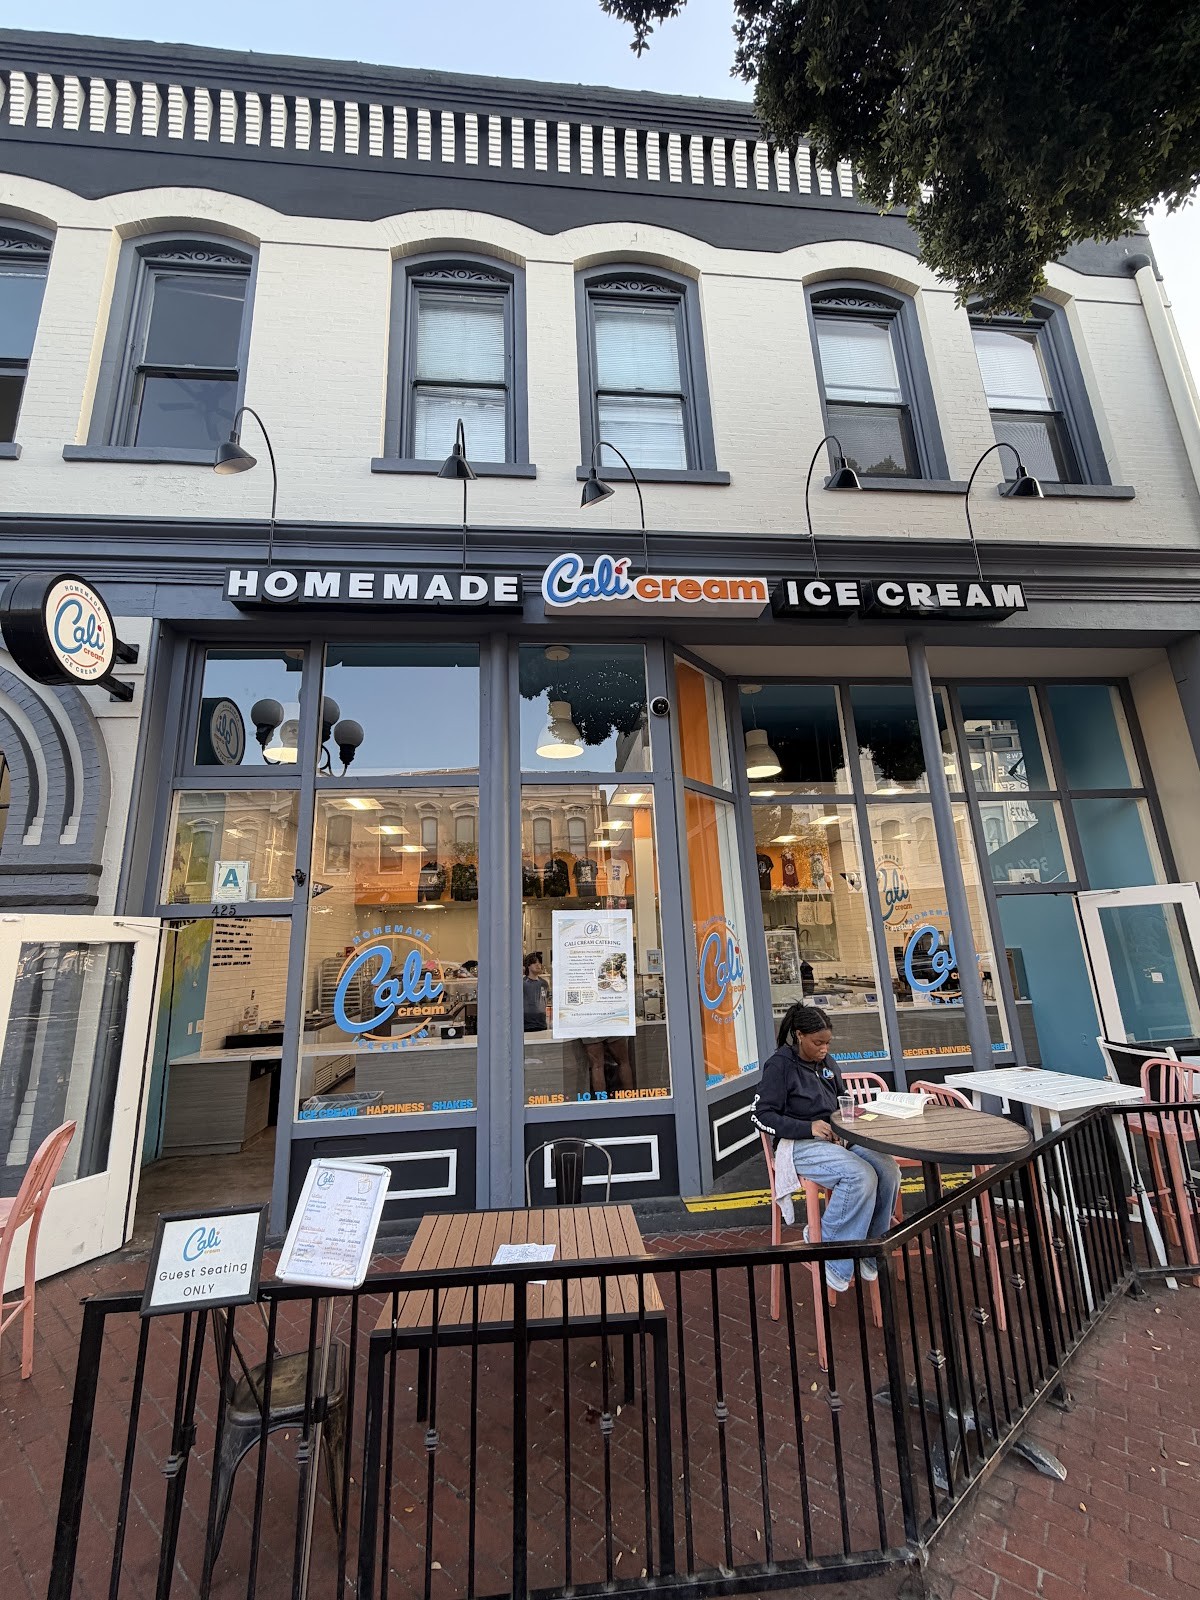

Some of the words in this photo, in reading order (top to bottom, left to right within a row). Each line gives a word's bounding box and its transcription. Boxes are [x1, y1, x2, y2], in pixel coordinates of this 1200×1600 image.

[227, 570, 519, 602] HOMEMADE
[544, 555, 631, 605] Cali
[636, 578, 766, 600] cream
[64, 585, 102, 611] HOMEMADE
[787, 580, 861, 607] ICE
[876, 581, 1025, 608] CREAM
[54, 599, 105, 654] Cali
[61, 654, 73, 668] ICE
[75, 666, 98, 675] CREAM
[83, 647, 105, 663] cream
[221, 868, 240, 887] A
[211, 904, 237, 916] 425
[352, 924, 432, 944] HOMEMADE
[700, 932, 744, 1010] Cali
[333, 945, 444, 1034] Cali
[728, 982, 747, 993] cream
[397, 1005, 445, 1017] cream
[944, 997, 964, 1005] CRE
[711, 1012, 723, 1025] ICE
[351, 1035, 375, 1050] ICE
[381, 1029, 429, 1051] CREAM
[863, 1050, 888, 1059] SPLITS
[903, 1047, 937, 1057] SECRETS
[528, 1094, 565, 1105] SMILES
[615, 1089, 640, 1099] HIGH
[640, 1088, 668, 1098] FIVES
[300, 1109, 317, 1120] ICE
[318, 1107, 358, 1119] CREAM
[366, 1102, 425, 1115] HAPPINESS
[432, 1099, 474, 1110] SHAKES
[316, 1172, 336, 1187] Cali
[182, 1226, 222, 1262] Cali
[159, 1268, 196, 1282] Guest
[200, 1262, 248, 1276] Seating
[183, 1283, 216, 1297] ONLY
